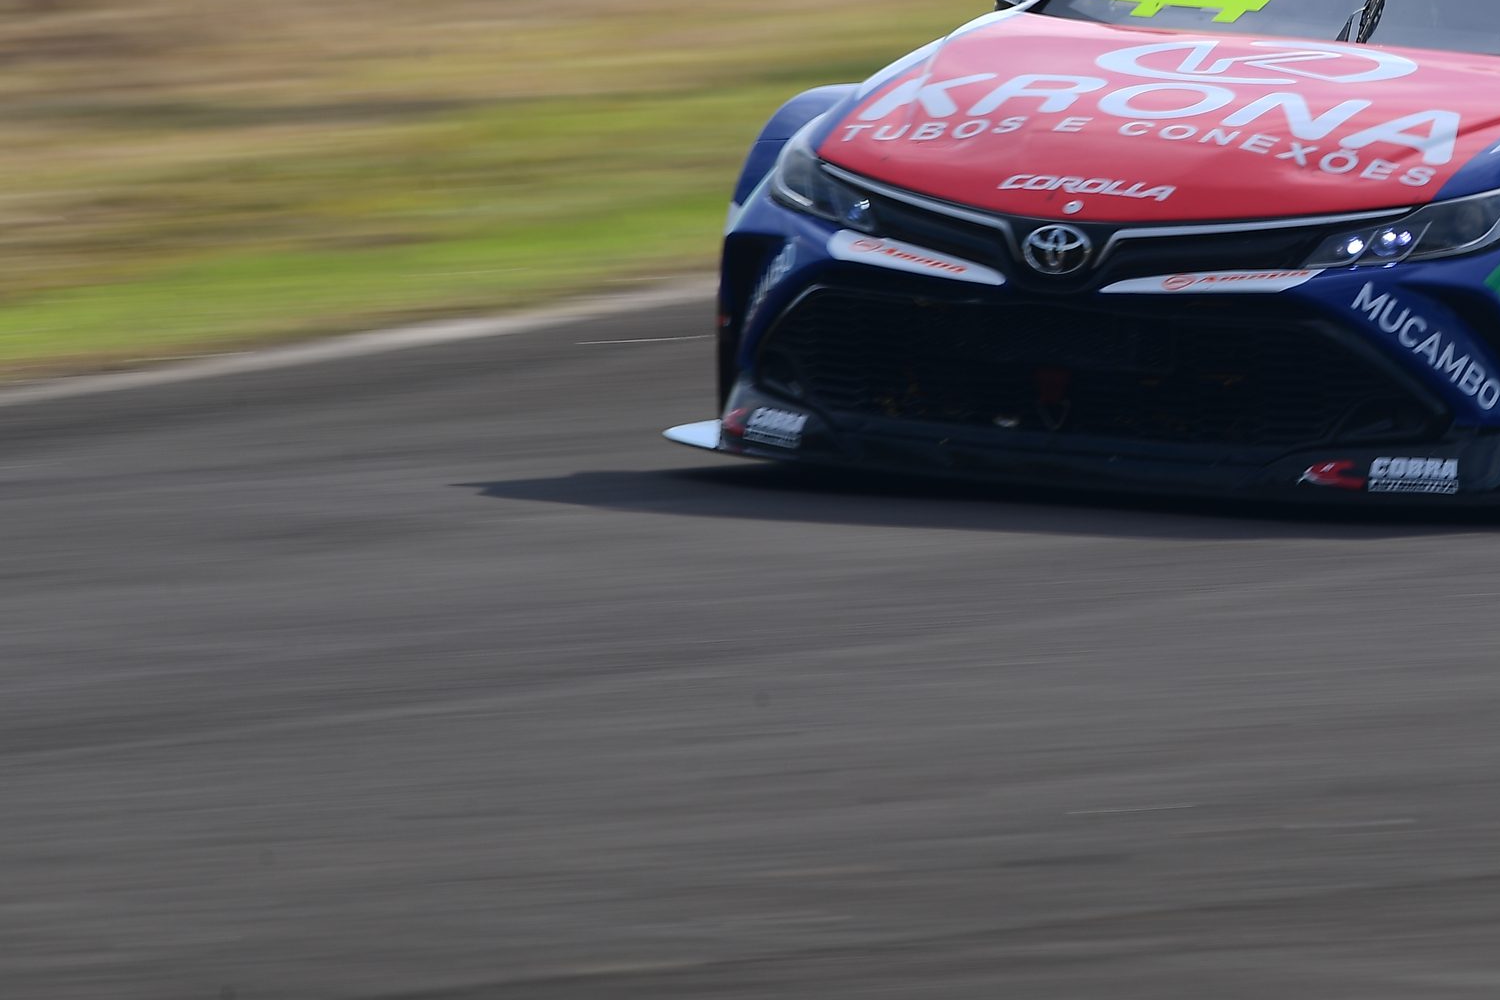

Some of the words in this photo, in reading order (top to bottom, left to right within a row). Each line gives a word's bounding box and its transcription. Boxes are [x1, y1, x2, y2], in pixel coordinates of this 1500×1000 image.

[842, 115, 1031, 143] TUBOS
[1053, 116, 1094, 132] E
[1118, 120, 1438, 189] CONEXÕES
[858, 72, 1462, 166] KRONA
[998, 174, 1177, 201] COROLLA
[1351, 281, 1500, 411] MUCAMBO
